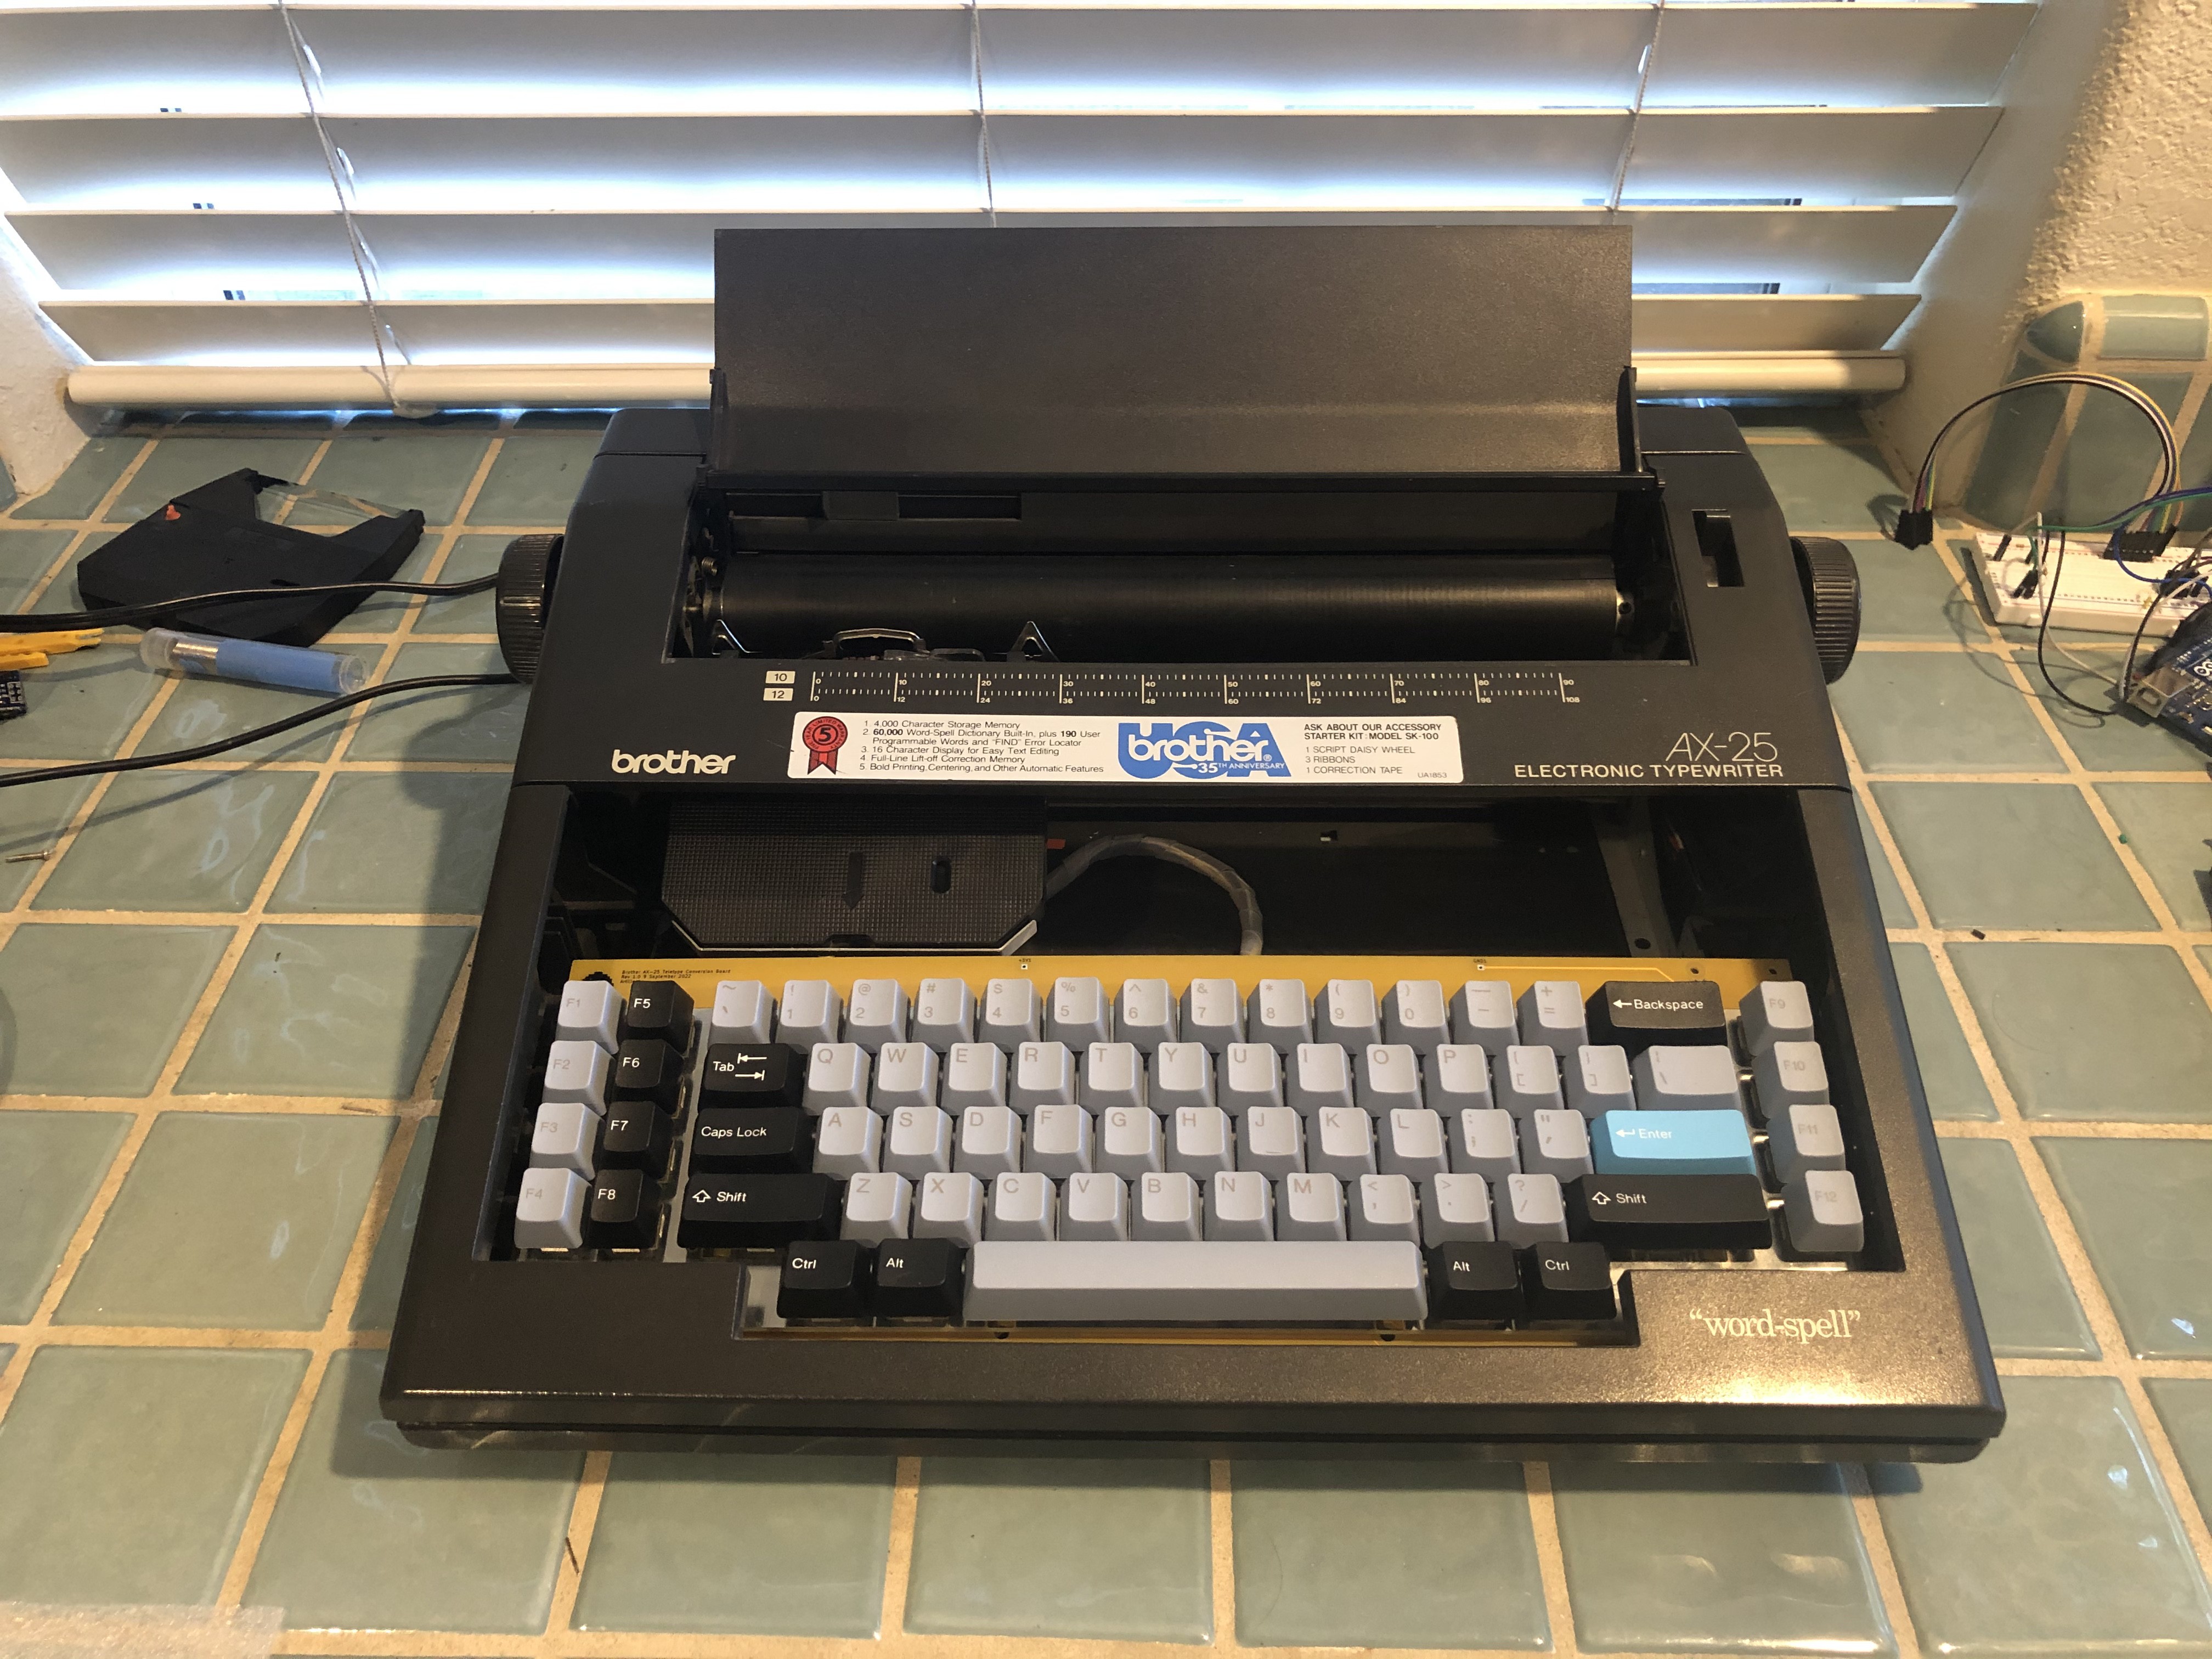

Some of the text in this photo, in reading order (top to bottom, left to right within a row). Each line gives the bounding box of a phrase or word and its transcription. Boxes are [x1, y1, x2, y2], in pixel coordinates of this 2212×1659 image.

[774, 673, 787, 681] 10
[772, 691, 784, 699] 12
[947, 721, 981, 730] Storage
[985, 721, 1020, 730] Memory
[819, 727, 831, 742] 5
[907, 729, 955, 737] Word-Spell
[872, 737, 936, 746] Programmable
[1665, 732, 1778, 762] AX-25
[933, 747, 964, 755] Display
[983, 747, 1004, 755] Easy
[1030, 748, 1059, 756] Editing
[1128, 735, 1268, 761] brother
[612, 749, 736, 774] brother
[990, 755, 1025, 764] Memory
[1514, 763, 1784, 778] ELECTRONIC TYPEWRITER
[566, 998, 580, 1008] F1
[634, 998, 651, 1009] F5
[1633, 999, 1703, 1011] Backspace
[1769, 998, 1786, 1009] F9
[787, 1008, 793, 1019] 1
[856, 1007, 865, 1019] 2
[924, 1007, 933, 1018] 3
[992, 1007, 1002, 1018] 4
[1060, 1005, 1069, 1017] 5
[1128, 1007, 1138, 1019] 6
[1197, 1007, 1206, 1018] 7
[1266, 1007, 1275, 1019] 8
[1334, 1008, 1344, 1019] 9
[1404, 1008, 1414, 1020] 0
[817, 1048, 833, 1064] Q
[887, 1048, 907, 1063] W
[956, 1048, 968, 1063] E
[1024, 1047, 1038, 1062] R
[1096, 1048, 1108, 1062] T
[1165, 1048, 1178, 1062] Y
[1234, 1048, 1247, 1063] U
[1304, 1048, 1308, 1063] I
[1373, 1049, 1389, 1064] O
[1443, 1049, 1456, 1063] P
[553, 1059, 571, 1070] F2
[623, 1057, 640, 1068] F6
[713, 1061, 735, 1072] Tab
[1784, 1060, 1805, 1071] F10
[828, 1113, 842, 1127] A
[899, 1111, 913, 1127] S
[969, 1111, 984, 1126] D
[1041, 1110, 1053, 1125] F
[1111, 1111, 1127, 1127] G
[1182, 1113, 1197, 1127] H
[1255, 1113, 1265, 1127] J
[1325, 1113, 1340, 1128] K
[1397, 1114, 1410, 1129] L
[540, 1122, 558, 1132] F3
[611, 1120, 629, 1131] F7
[1797, 1124, 1818, 1135] F11
[701, 1126, 766, 1138] Caps Lock
[1638, 1128, 1672, 1139] Enter
[856, 1178, 871, 1193] Z
[930, 1178, 945, 1194] X
[1003, 1178, 1019, 1193] C
[1077, 1178, 1090, 1193] V
[1148, 1178, 1161, 1193] B
[1221, 1177, 1235, 1192] N
[1294, 1178, 1312, 1194] M
[526, 1188, 543, 1199] F4
[598, 1189, 616, 1200] F8
[716, 1191, 747, 1202] Shift
[1616, 1193, 1647, 1204] Shift
[1814, 1190, 1837, 1203] F12
[792, 1258, 817, 1269] Ctrl
[885, 1257, 904, 1268] Alt
[1453, 1261, 1470, 1272] Alt
[1545, 1259, 1569, 1271] Ctrl
